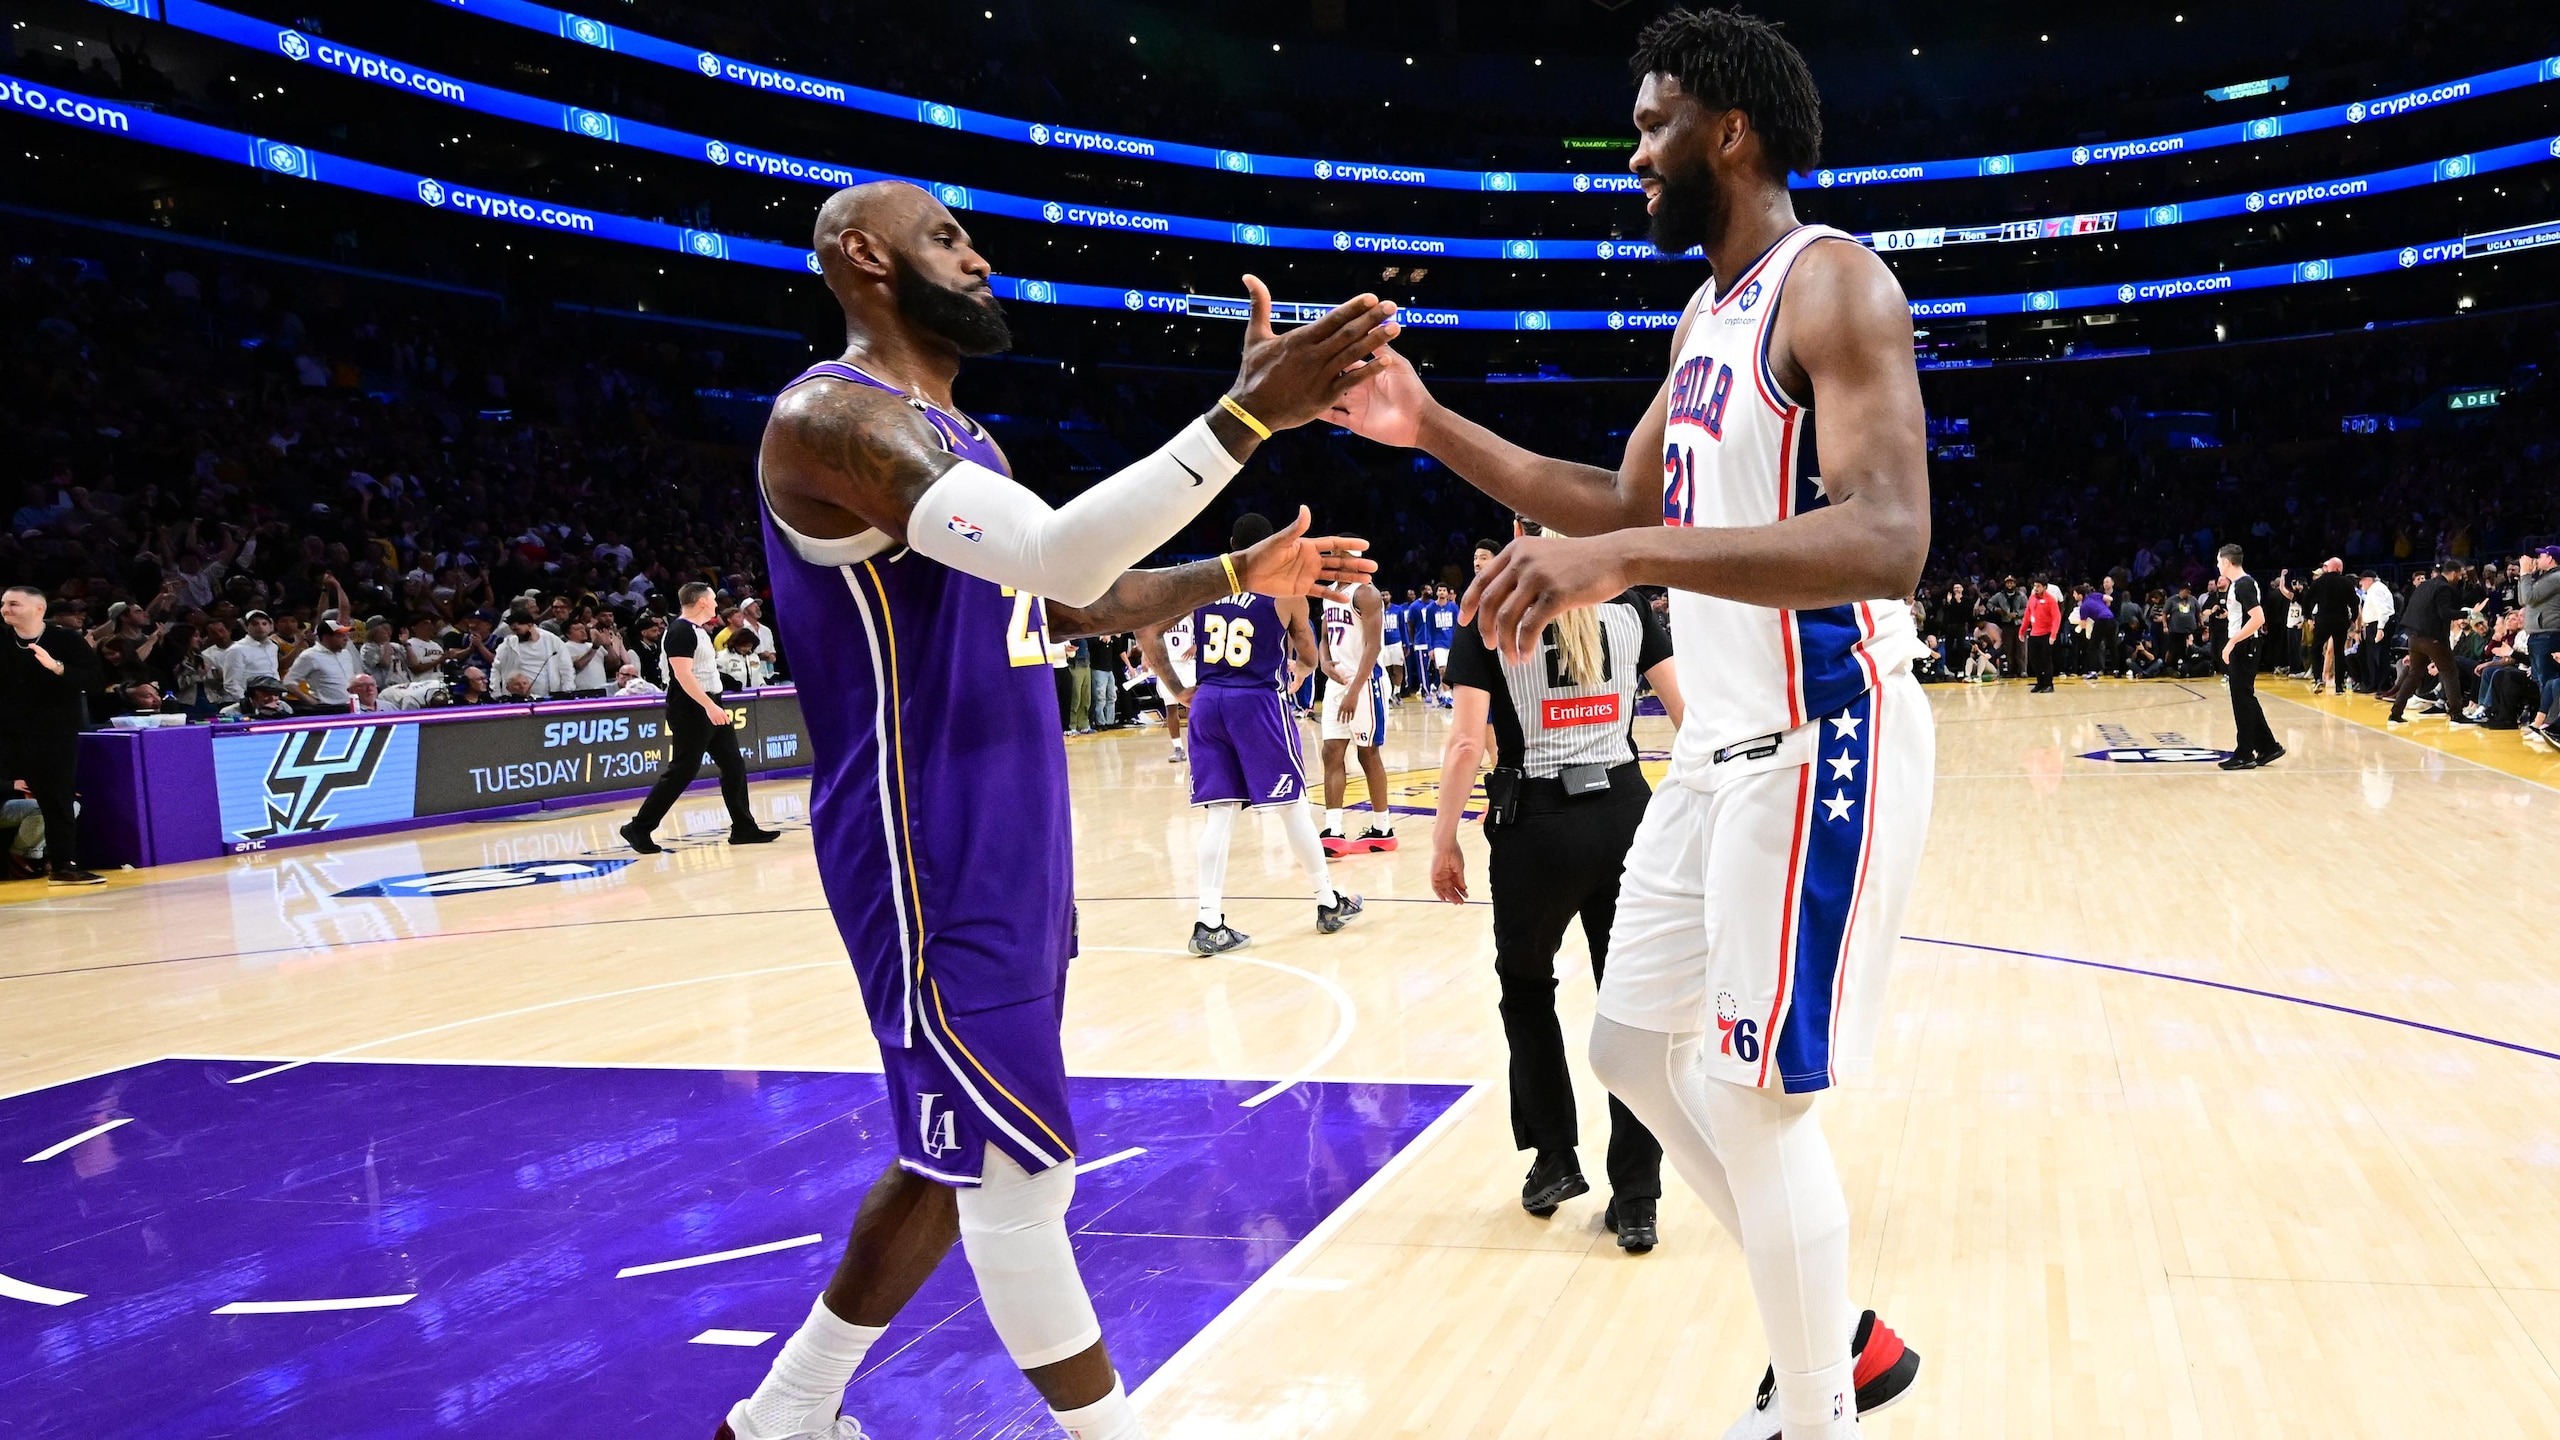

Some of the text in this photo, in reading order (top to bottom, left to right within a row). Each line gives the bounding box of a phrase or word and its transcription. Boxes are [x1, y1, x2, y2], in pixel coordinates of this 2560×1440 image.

[318, 46, 465, 102] crypto.com
[726, 60, 845, 103] crypto.com
[2223, 79, 2269, 94] AMERICAN
[2370, 82, 2471, 117] crypto.com
[1054, 128, 1155, 157] crypto.com
[2093, 137, 2184, 161] crypto.com
[734, 150, 854, 188] crypto.com
[1335, 164, 1426, 184] crypto.com
[1837, 166, 1924, 186] crypto.com
[2268, 179, 2368, 206] crypto.com
[451, 190, 594, 233] crypto.com
[1068, 208, 1169, 233] crypto.com
[2007, 222, 2037, 239] 115
[2085, 222, 2093, 231] 4
[2103, 221, 2109, 230] 1
[1354, 235, 1445, 254] crypto.com
[1888, 232, 1915, 249] 0.0
[1933, 235, 1941, 246] 4
[1959, 231, 1987, 241] 76ers
[2487, 241, 2511, 251] UCLA
[2139, 275, 2232, 300] crypto.com
[1208, 306, 1230, 316] UCLA
[1663, 443, 1696, 527] 21
[2290, 609, 2300, 618] 23
[1001, 584, 1054, 668] 2
[1327, 626, 1345, 646] 77
[1171, 636, 1180, 649] 0
[1203, 614, 1255, 668] 36
[1550, 703, 1613, 721] Emirates
[543, 717, 630, 747] SPURS
[1355, 731, 1368, 742] 76
[644, 749, 661, 761] PM
[766, 742, 782, 759] NBA
[783, 741, 797, 756] APP
[469, 751, 644, 794] TUESDAY 7:30
[645, 761, 659, 773] PT
[1268, 773, 1293, 799] LA
[236, 840, 266, 850] anc
[1717, 1012, 1760, 1063] 76
[916, 1092, 962, 1160] LA
